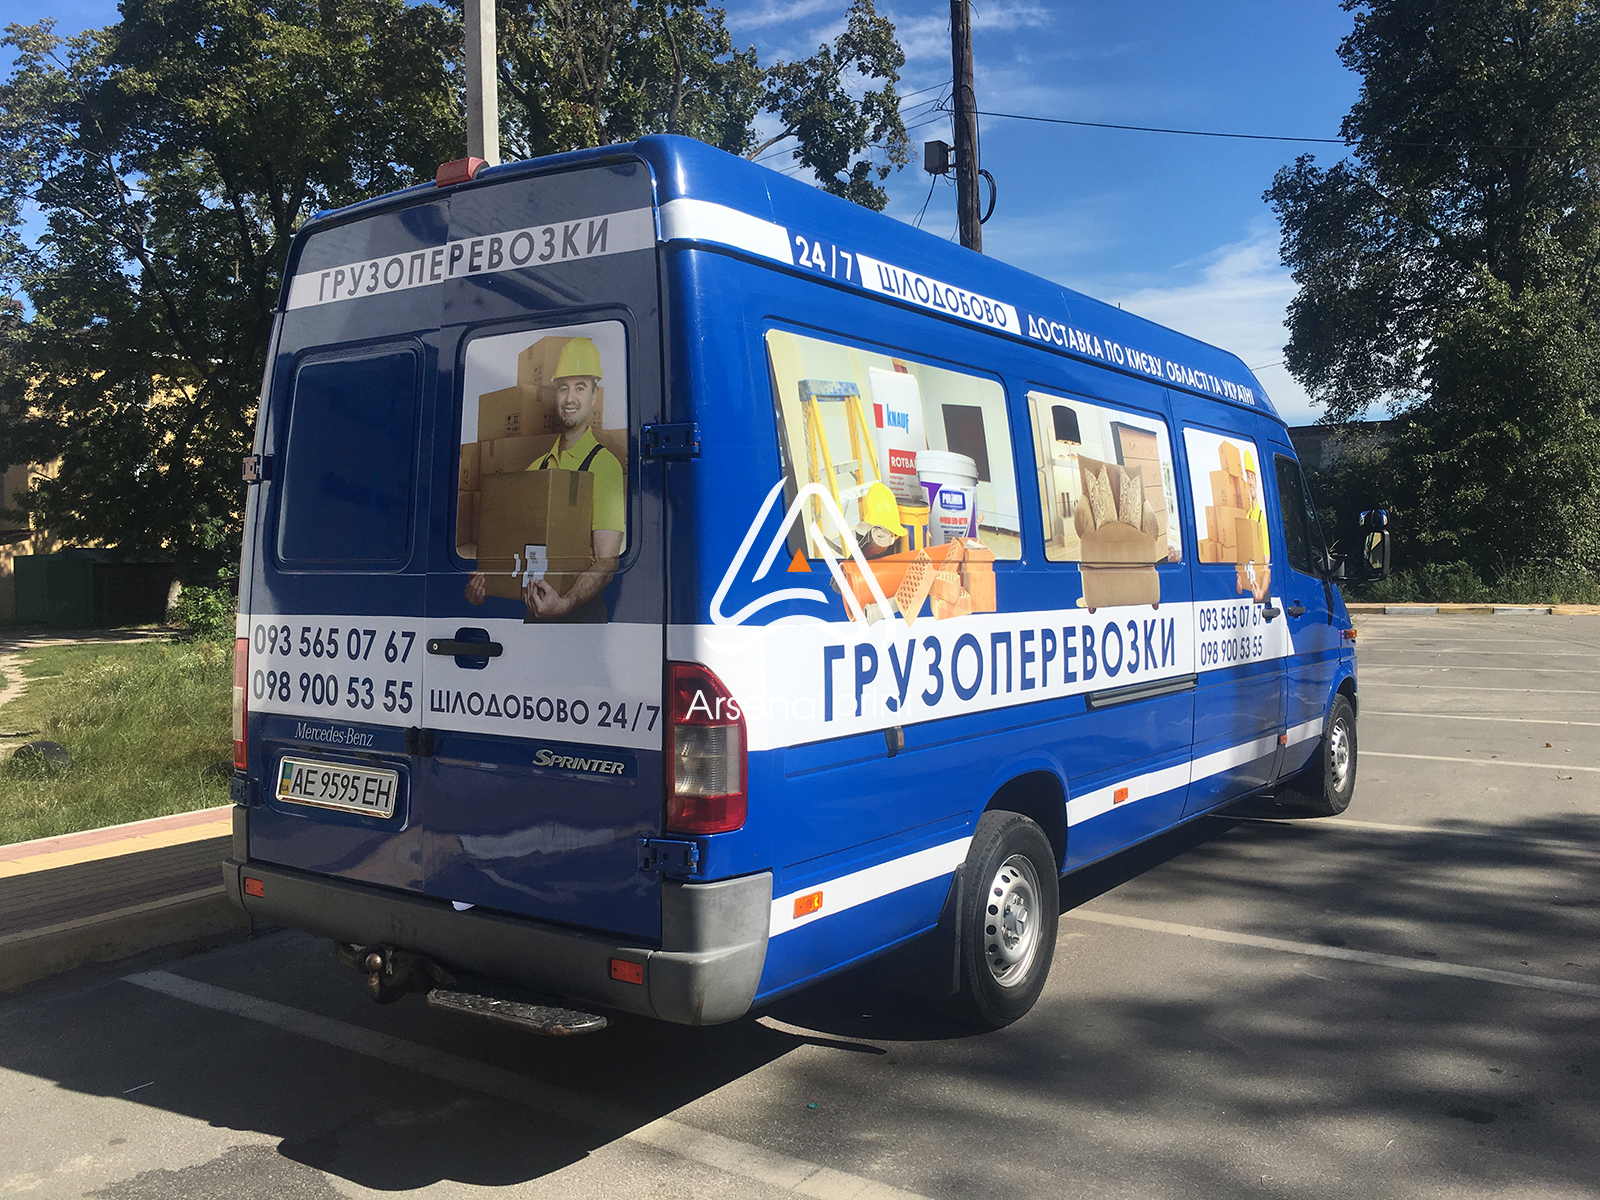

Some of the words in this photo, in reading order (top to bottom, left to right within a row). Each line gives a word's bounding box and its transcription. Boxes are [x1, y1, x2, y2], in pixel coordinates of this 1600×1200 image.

[318, 218, 609, 302] ГРУЗОПЕРЕВОЗКИ
[795, 235, 852, 281] 24/7
[877, 263, 1007, 327] ЦІЛОДОБОВО
[1028, 314, 1104, 360] ДОСТАВКА
[1104, 340, 1124, 365] ПО
[1166, 361, 1210, 391] ОБЛАСТІ
[1208, 375, 1223, 395] ТА
[891, 456, 917, 469] ROTBA
[1199, 608, 1218, 632] 093
[1221, 606, 1237, 630] 565
[1239, 605, 1249, 628] 07
[1252, 604, 1262, 626] 67
[254, 624, 291, 656] 093
[299, 626, 339, 659] 565
[347, 629, 376, 661] 07
[385, 631, 416, 664] 67
[1200, 642, 1218, 666] 098
[1221, 638, 1237, 662] 900
[1240, 636, 1250, 659] 53
[1252, 634, 1262, 657] 55
[823, 617, 1175, 722] ГРУЗОПЕРЕВОЗКИ
[253, 671, 291, 702] 098
[299, 673, 339, 706] 900
[347, 677, 374, 709] 53
[384, 680, 413, 714] 55
[430, 689, 590, 726] ЦІЛОДОБОВО
[597, 701, 661, 732] 24/7
[294, 722, 374, 747] Mercedes-Benz
[532, 749, 625, 775] SPRINTER
[281, 784, 289, 792] UA
[291, 768, 318, 797] AE
[319, 772, 361, 803] 9595
[362, 777, 392, 808] EH
